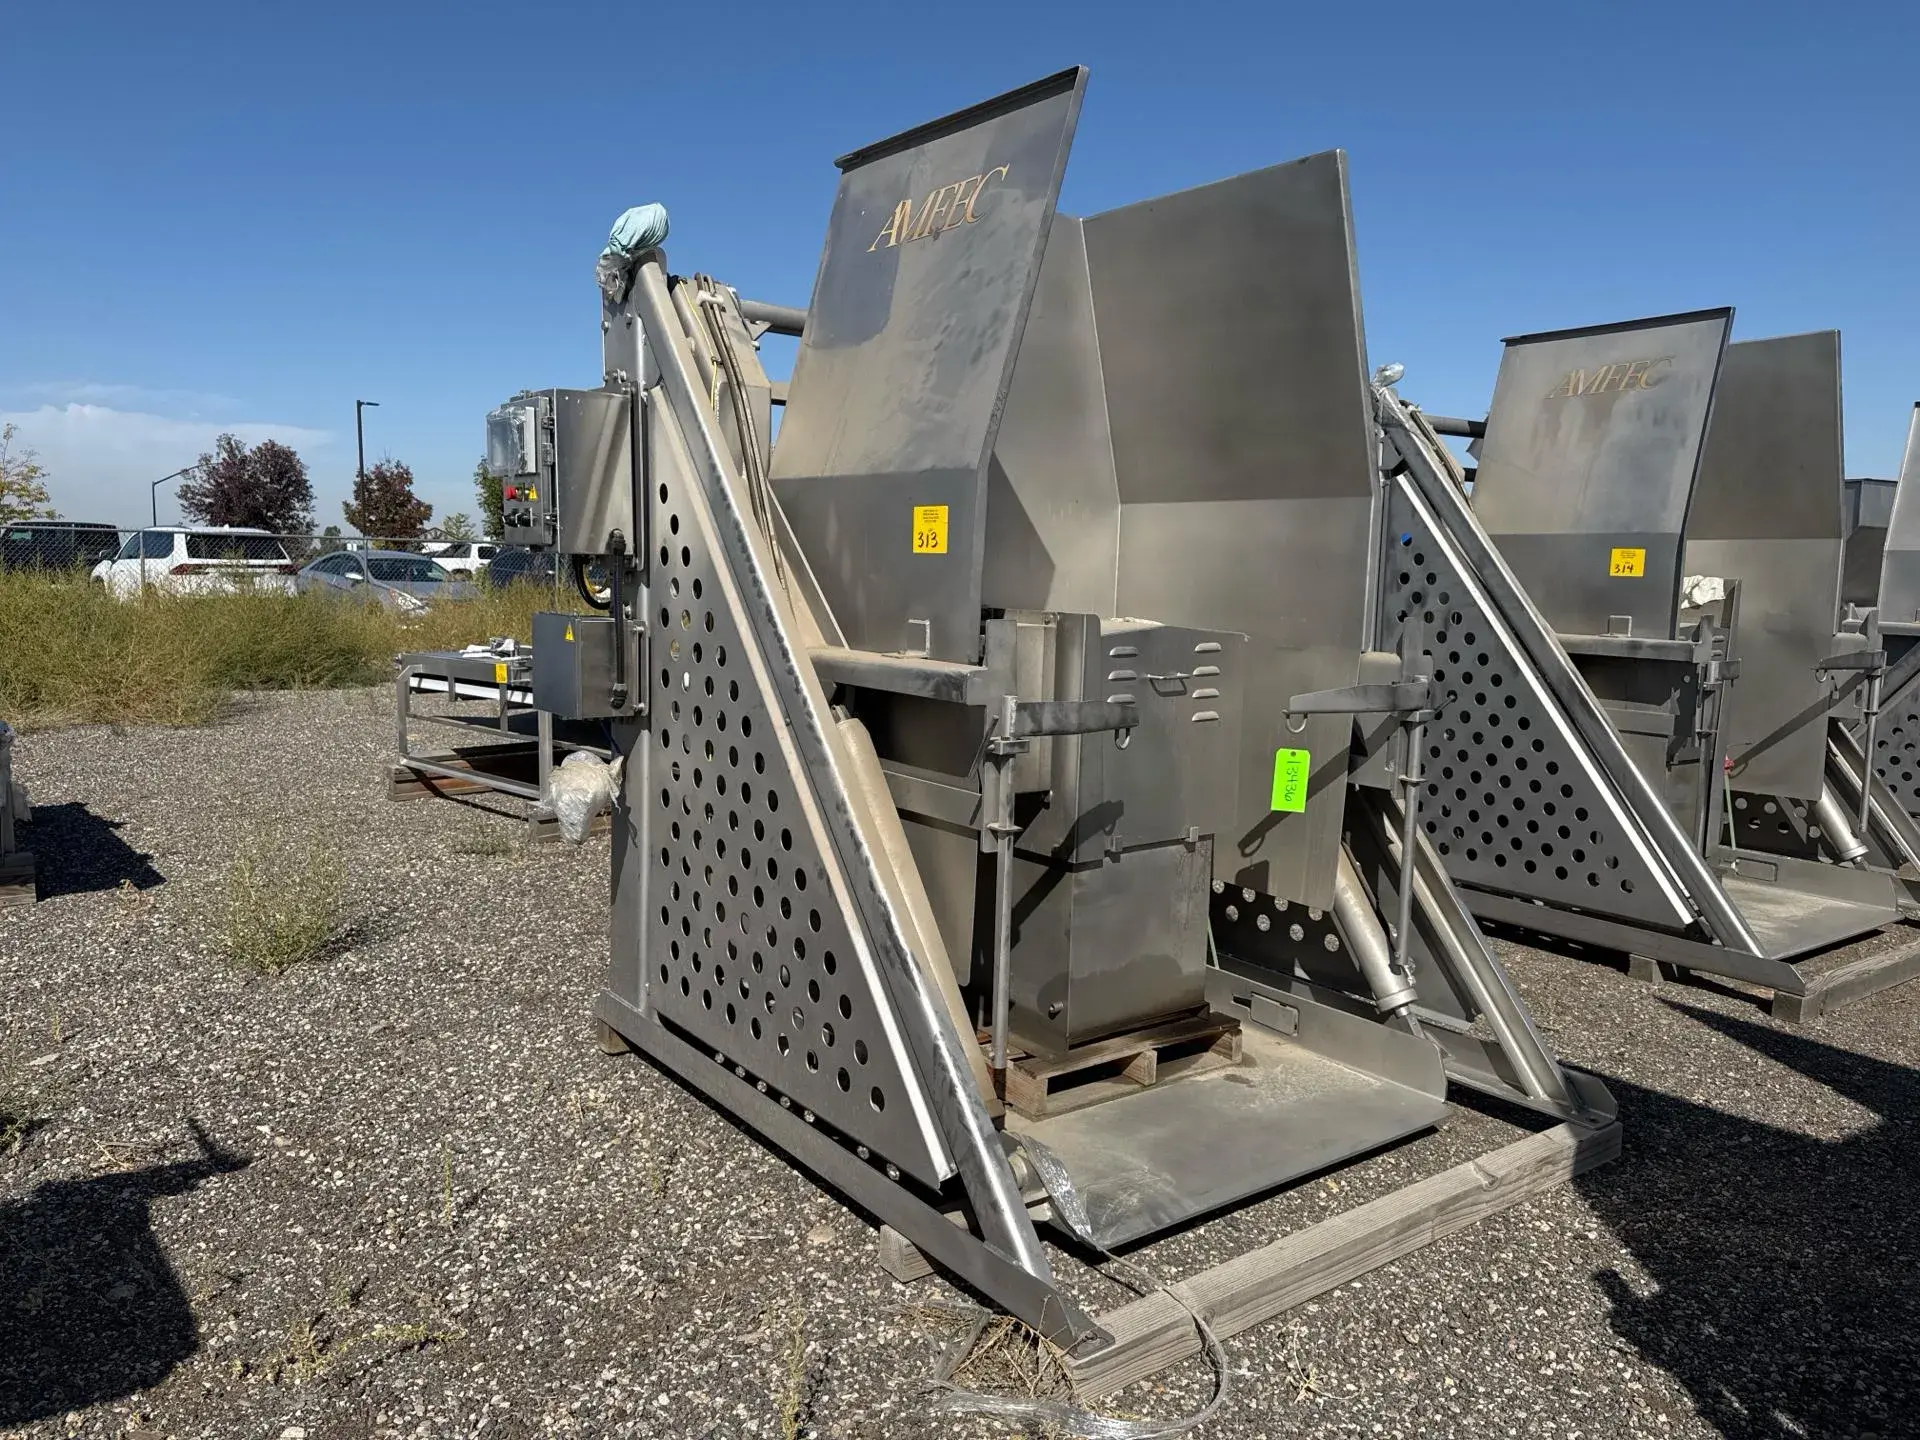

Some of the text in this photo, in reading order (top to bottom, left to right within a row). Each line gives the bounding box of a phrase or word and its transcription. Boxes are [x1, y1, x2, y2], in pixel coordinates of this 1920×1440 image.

[866, 163, 1010, 252] AMFEC
[918, 531, 938, 548] 313
[1614, 563, 1634, 573] 314
